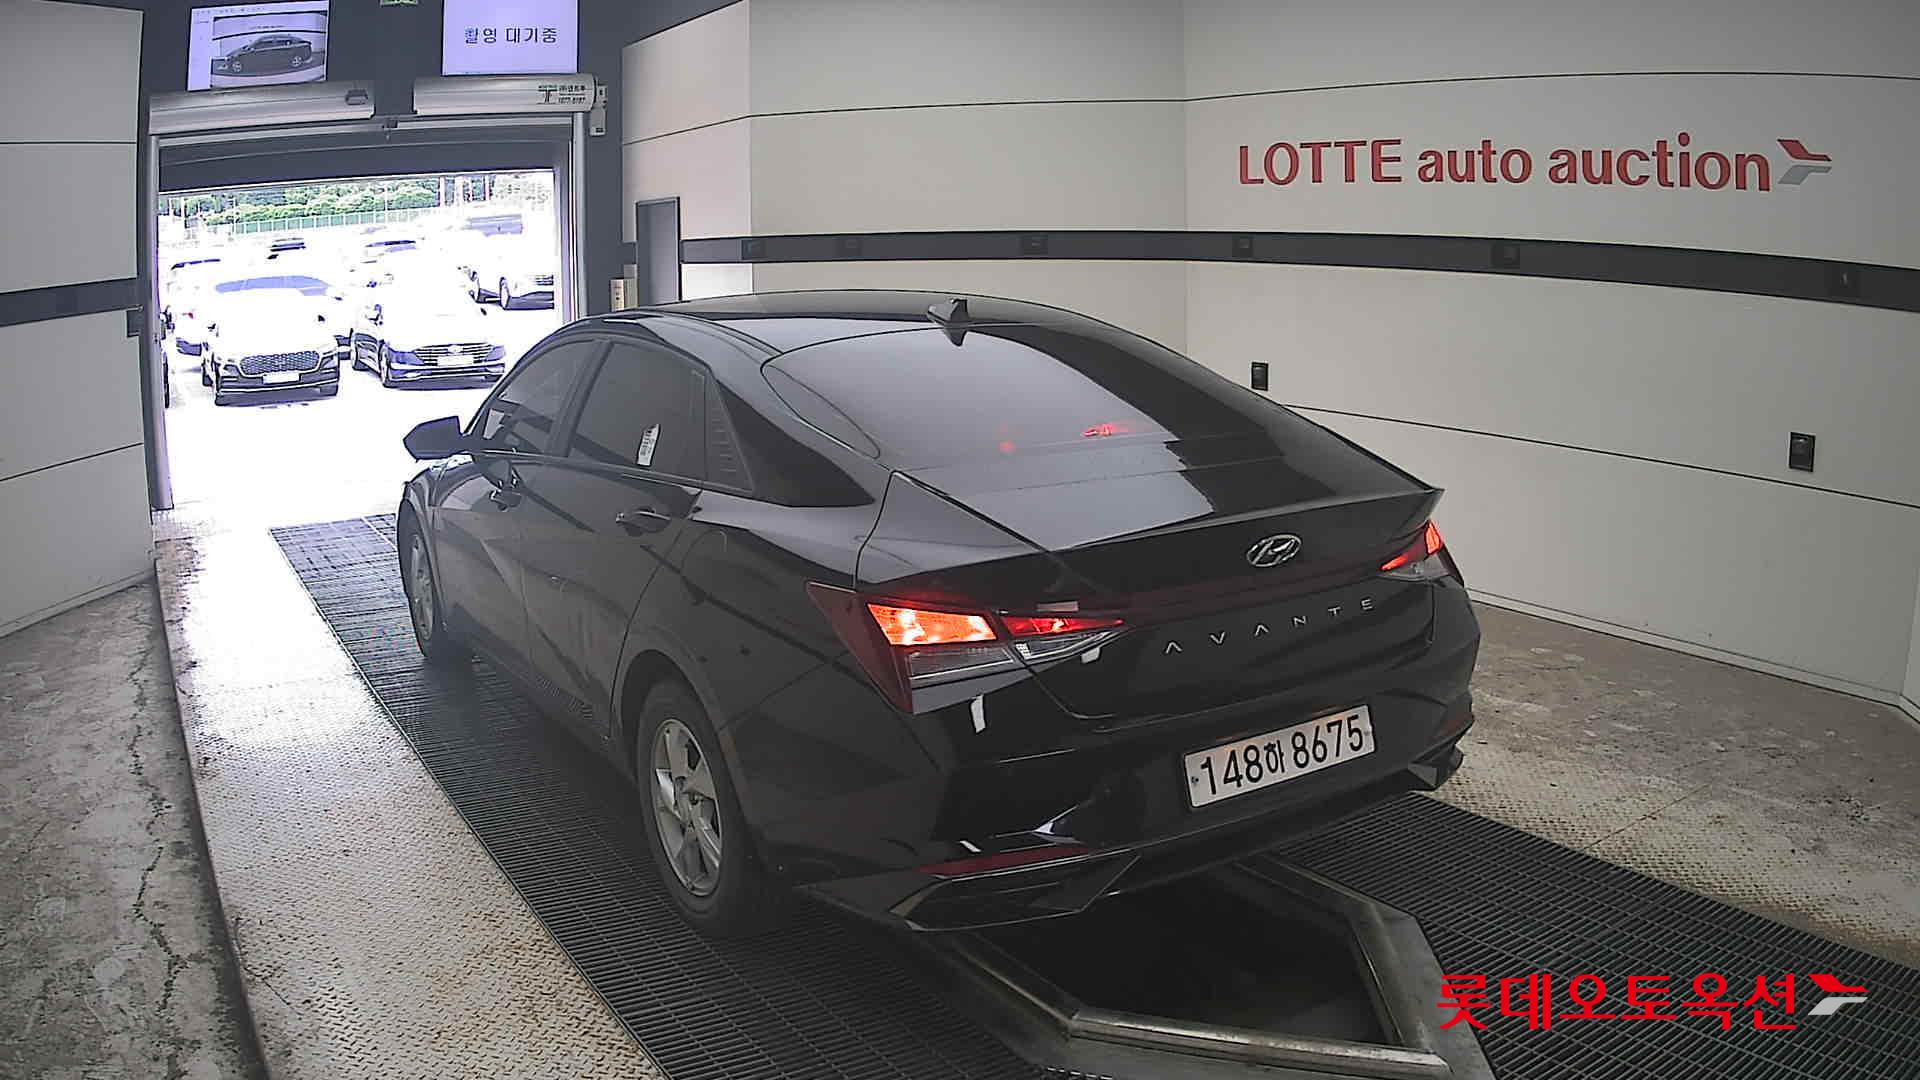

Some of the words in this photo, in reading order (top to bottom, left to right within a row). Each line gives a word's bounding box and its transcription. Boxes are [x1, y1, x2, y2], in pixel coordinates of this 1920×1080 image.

[505, 27, 558, 44] 대기중
[1238, 138, 1402, 185] LOTTE
[1417, 139, 1532, 185] auto
[1548, 132, 1771, 192] auction
[1165, 598, 1375, 654] AVANTE
